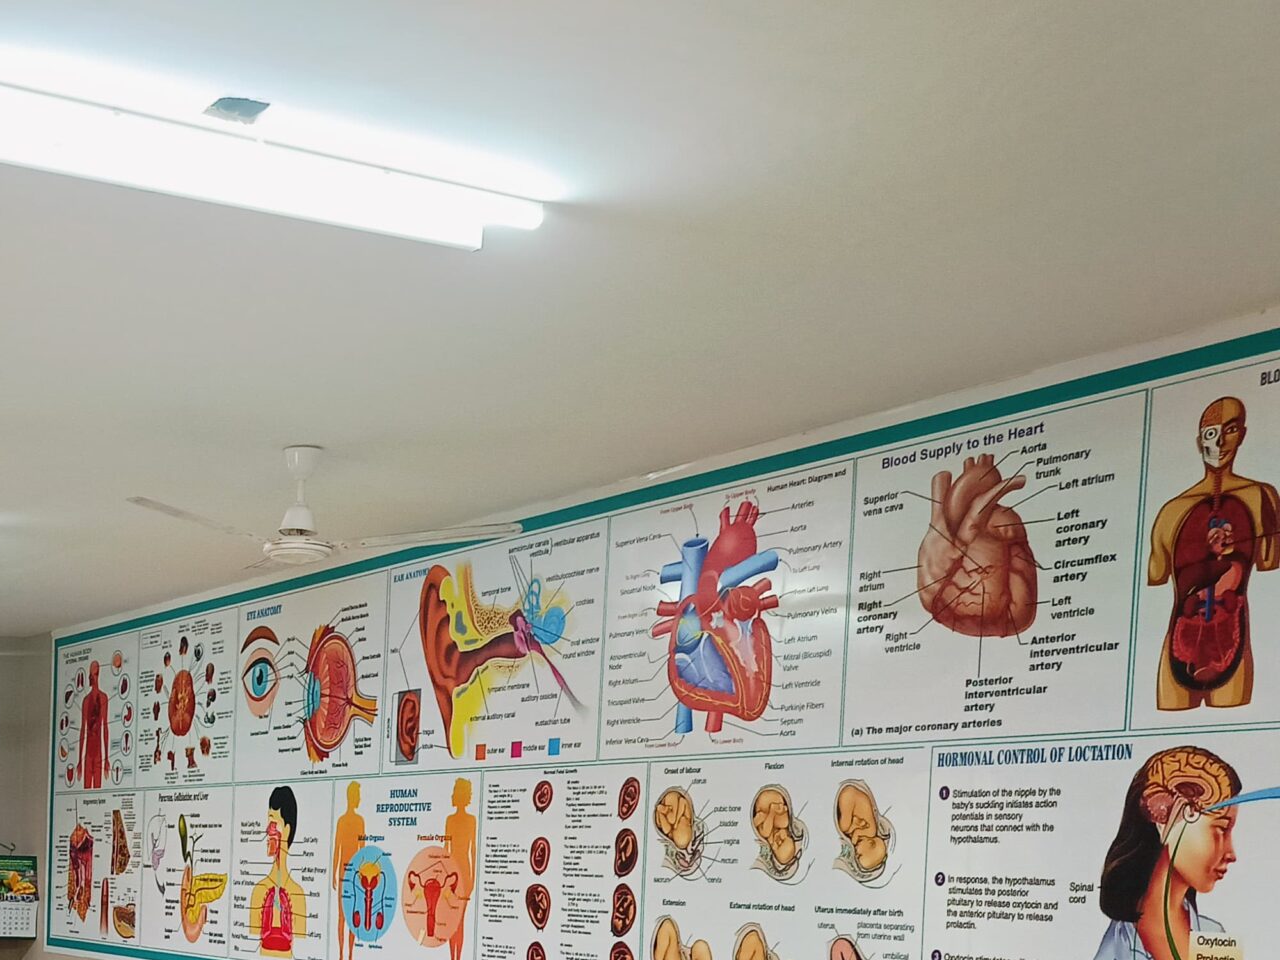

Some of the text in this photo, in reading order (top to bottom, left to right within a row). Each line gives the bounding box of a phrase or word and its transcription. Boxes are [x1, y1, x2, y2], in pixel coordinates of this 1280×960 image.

[882, 422, 1044, 469] Blood Supply to the Heart
[1020, 442, 1047, 455] Aorta
[1036, 449, 1091, 466] Pulmonary
[1036, 467, 1061, 479] trunk
[1059, 473, 1115, 490] Left atrium
[863, 492, 898, 506] Superior
[863, 503, 903, 517] vena cava
[1057, 509, 1079, 520] Left
[1056, 519, 1107, 534] coronary
[1055, 535, 1090, 547] artery
[1054, 554, 1117, 569] Circumflex
[405, 568, 428, 580] ANATOM
[859, 571, 881, 582] Right
[1053, 572, 1087, 583] artery
[859, 581, 885, 593] atrium
[857, 601, 882, 612] Right
[1051, 596, 1072, 607] Left
[247, 604, 282, 621] EYE ANATOMY
[857, 610, 898, 623] coronary
[1051, 607, 1095, 619] ventricle
[856, 624, 884, 635] artery
[885, 631, 907, 643] Right
[1030, 633, 1076, 646] Anterior
[885, 642, 921, 653] ventricle
[1030, 641, 1120, 658] interventricular
[1029, 660, 1062, 671] artery
[966, 676, 1013, 687] Posterior
[965, 685, 1047, 699] interventricular
[964, 702, 995, 712] artery
[851, 718, 1002, 737] (a) The major coronary arteries
[937, 743, 1133, 767] HORMONAL CONTROL OF LOCTATION
[942, 788, 947, 798] 1
[952, 788, 1061, 799] Stimulation of the nipple by the
[376, 789, 432, 826] HUMAN REPRODUCTIVE SYSTEM
[952, 801, 973, 810] baby's
[1006, 800, 1033, 809] initiates
[1035, 800, 1057, 808] action
[951, 812, 1023, 822] potentials in sensory
[951, 823, 1054, 832] neurons that connect with the
[950, 835, 1000, 845] hypothalamus.
[937, 875, 942, 883] 2
[948, 875, 954, 883] In
[992, 876, 1003, 884] the
[1005, 877, 1055, 887] hypothalamus
[948, 886, 1029, 897] stimulates the posterior
[1069, 883, 1094, 893] Spinal
[947, 898, 974, 908] pituitary
[984, 900, 1010, 908] release
[1012, 901, 1042, 910] oxytocin
[1044, 901, 1058, 910] and
[1069, 895, 1086, 904] cord
[947, 909, 1053, 922] the anterior pituitary to release
[946, 921, 976, 930] prolactin.
[1197, 935, 1237, 948] Oxytocin
